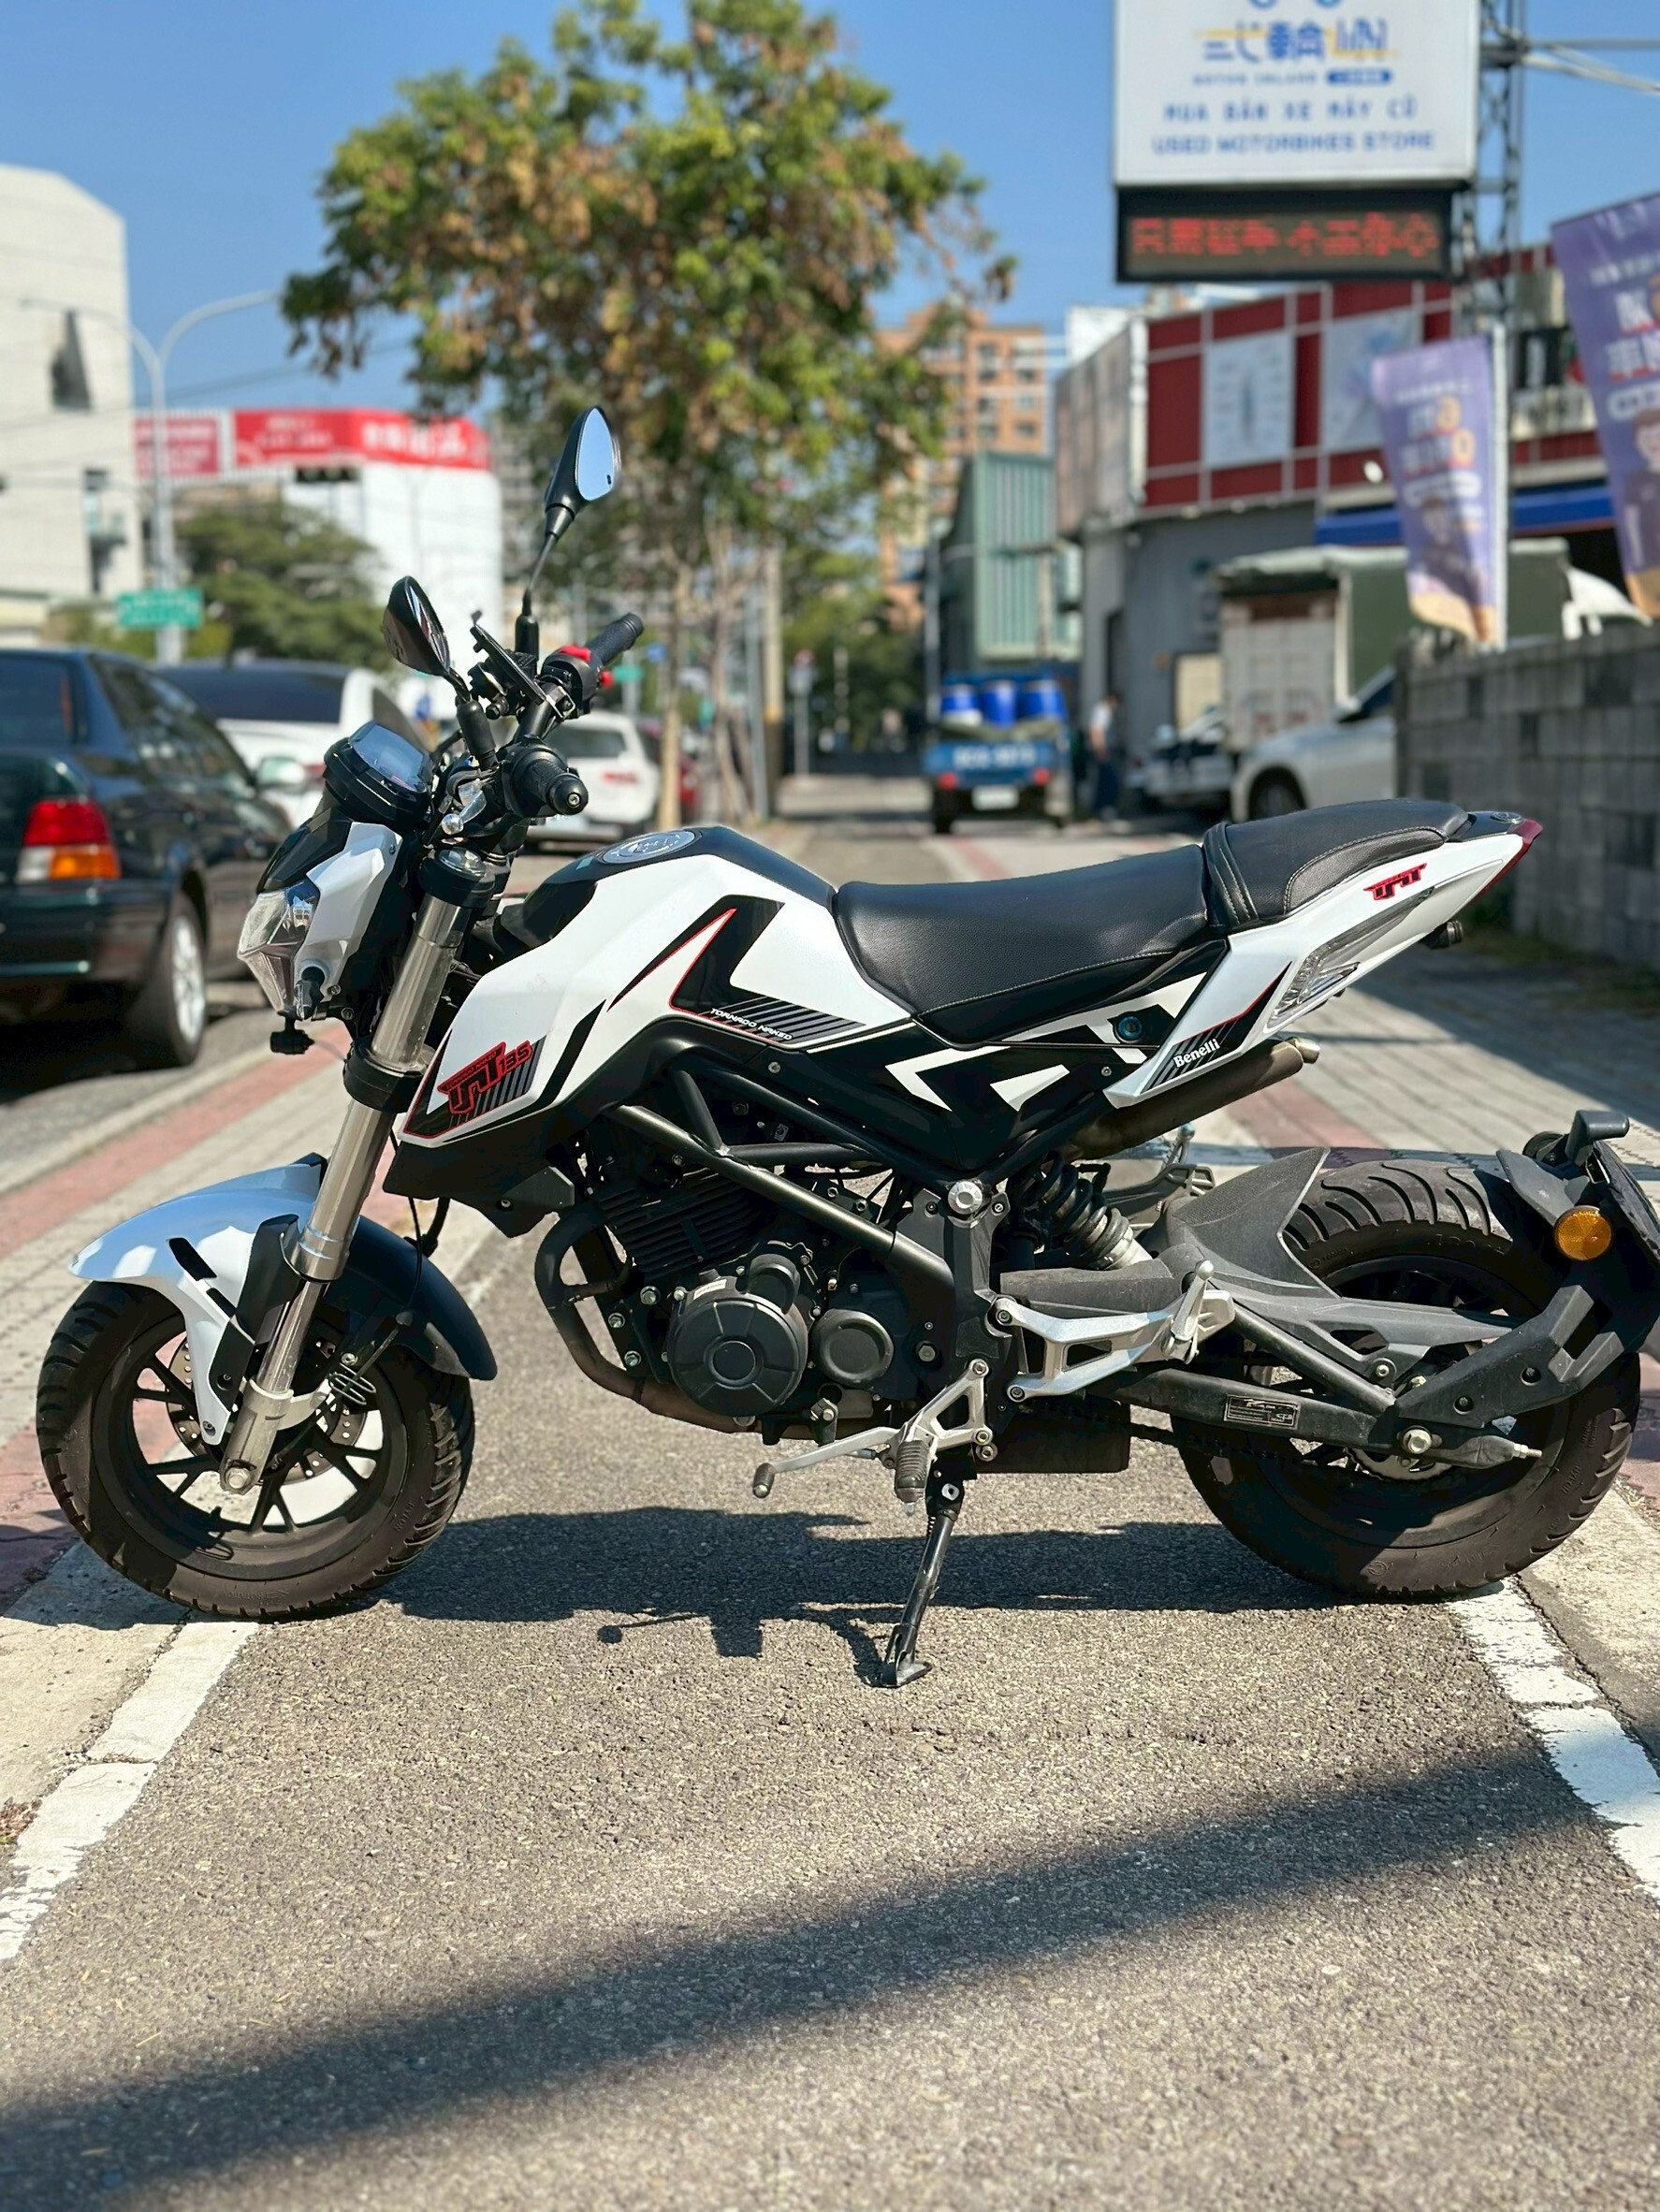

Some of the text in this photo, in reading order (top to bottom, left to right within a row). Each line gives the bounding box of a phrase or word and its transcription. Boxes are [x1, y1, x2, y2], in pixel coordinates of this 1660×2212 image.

[1151, 130, 1434, 156] USED MOTORBIKES STORE
[709, 1008, 793, 1041] TORNADO NAKED
[1172, 1039, 1221, 1068] Benelli
